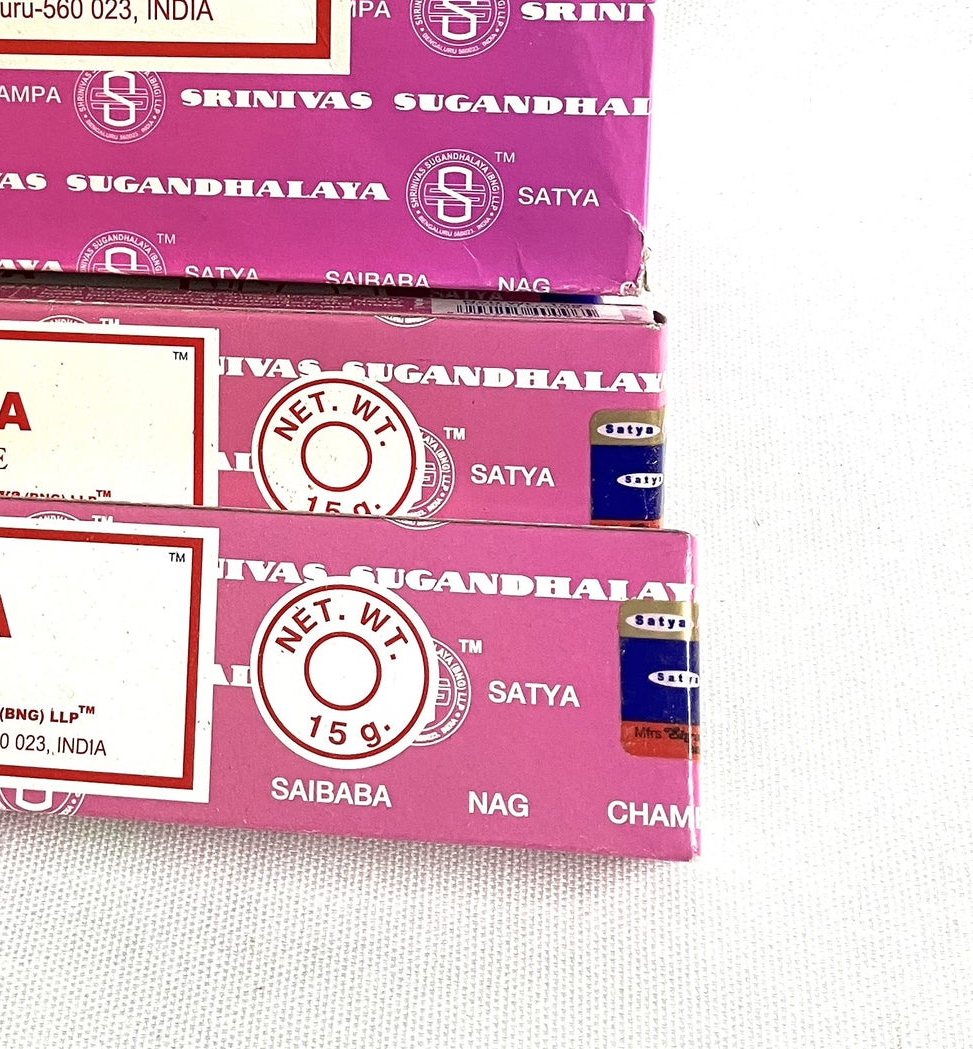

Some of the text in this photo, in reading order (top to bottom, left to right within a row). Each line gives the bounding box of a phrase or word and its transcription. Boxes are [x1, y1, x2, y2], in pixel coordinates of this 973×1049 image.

[180, 88, 373, 110] SRINIVAS
[66, 174, 390, 201] SUGANDHALAYA
[494, 151, 600, 207] TM SATYA
[156, 232, 551, 293] TM NAG
[172, 350, 188, 361] TM
[274, 391, 397, 447] NET. WT.
[606, 424, 654, 436] Satya
[442, 427, 555, 487] TM SATYA
[168, 552, 186, 563] TM
[276, 598, 409, 660] NET. WT.
[635, 615, 686, 629] Satya
[458, 639, 581, 708] TM SATYA
[13, 731, 52, 756] 023,
[57, 736, 107, 757] INDIA
[309, 714, 391, 748] 15 g.
[271, 776, 392, 808] SAIBABA
[468, 790, 529, 818] NAG
